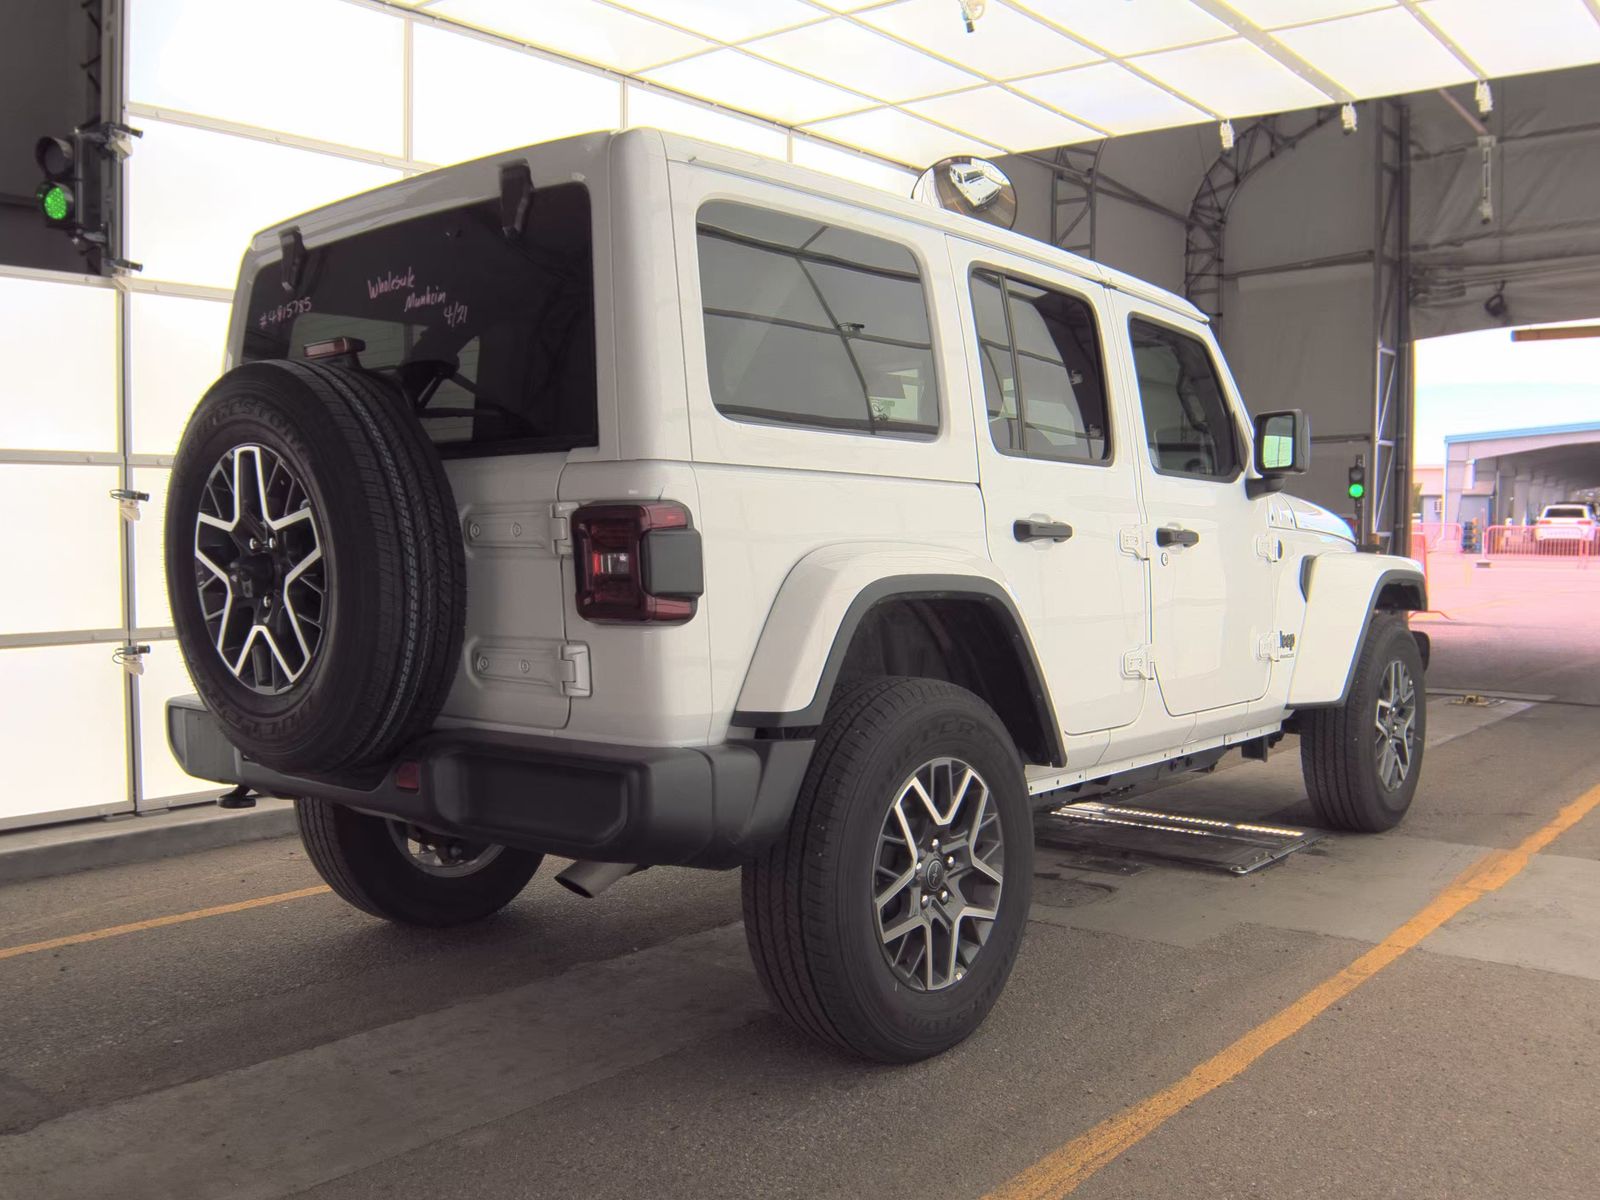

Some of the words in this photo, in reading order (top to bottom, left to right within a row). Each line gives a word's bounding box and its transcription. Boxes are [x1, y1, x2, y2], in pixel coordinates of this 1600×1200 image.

[367, 265, 416, 300] Wholesale
[403, 284, 447, 313] Manheim
[443, 300, 469, 328] 4/21
